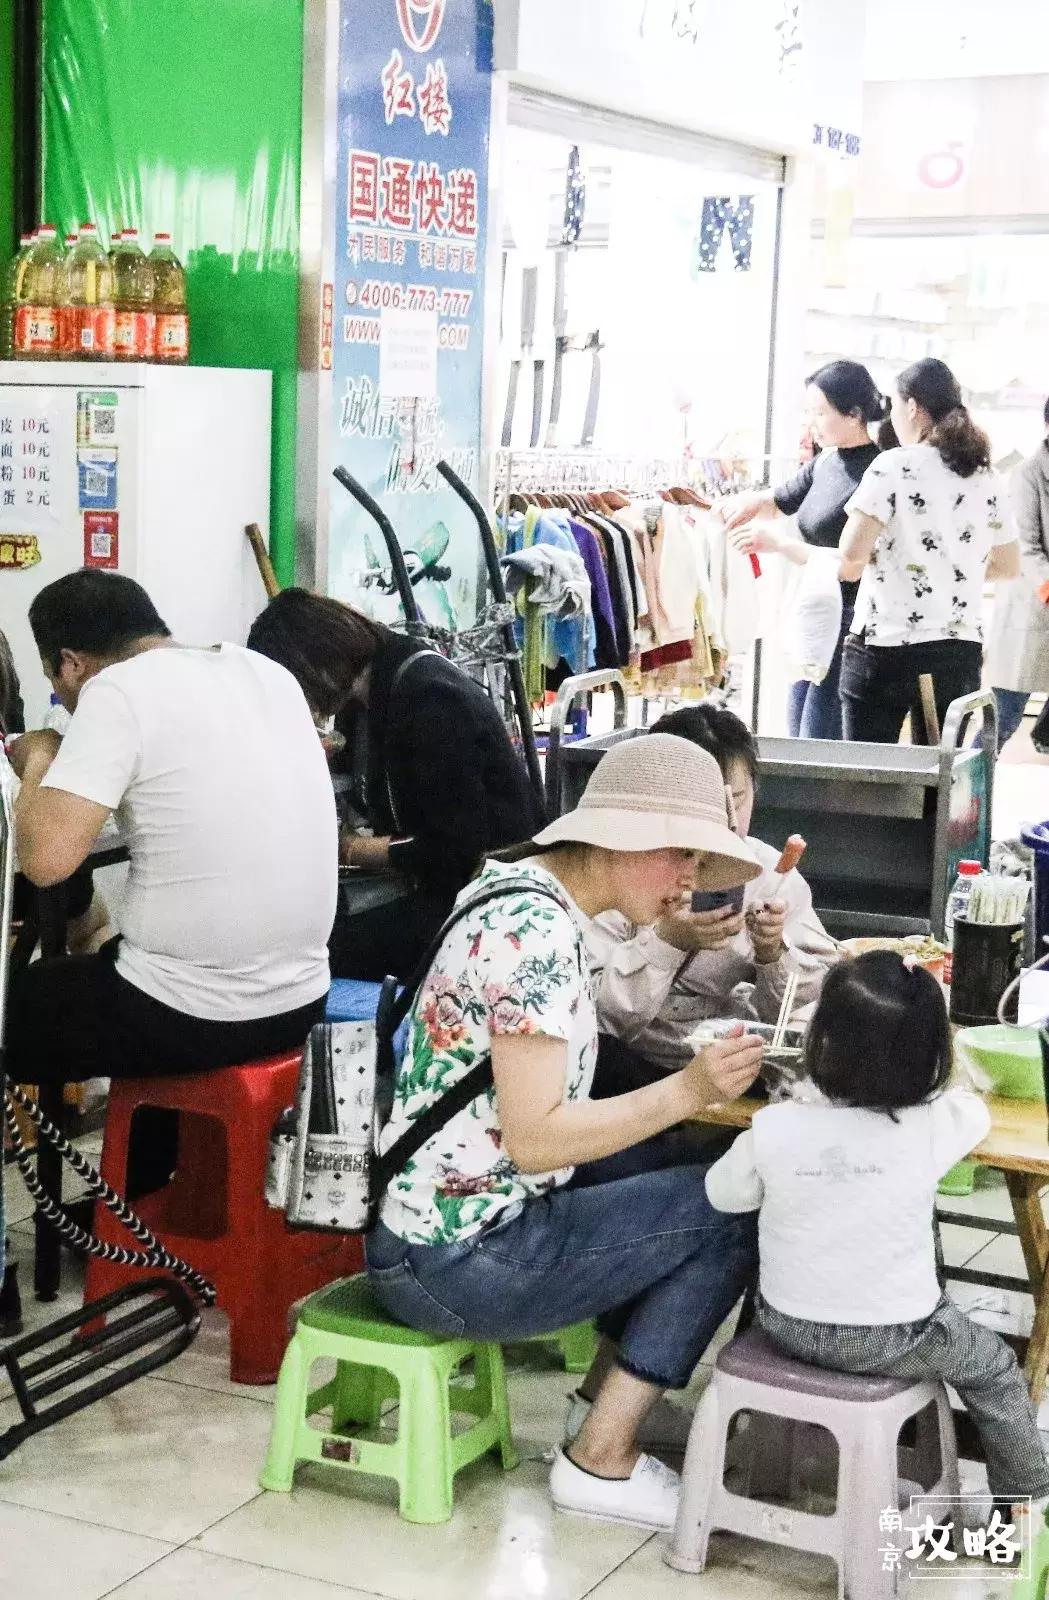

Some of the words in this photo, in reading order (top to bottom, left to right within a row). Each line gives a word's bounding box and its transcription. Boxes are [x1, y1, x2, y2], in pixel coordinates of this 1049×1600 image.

[348, 150, 477, 236] 国通快递
[419, 241, 477, 272] 和谐万家
[361, 280, 471, 315] 4006-773-777
